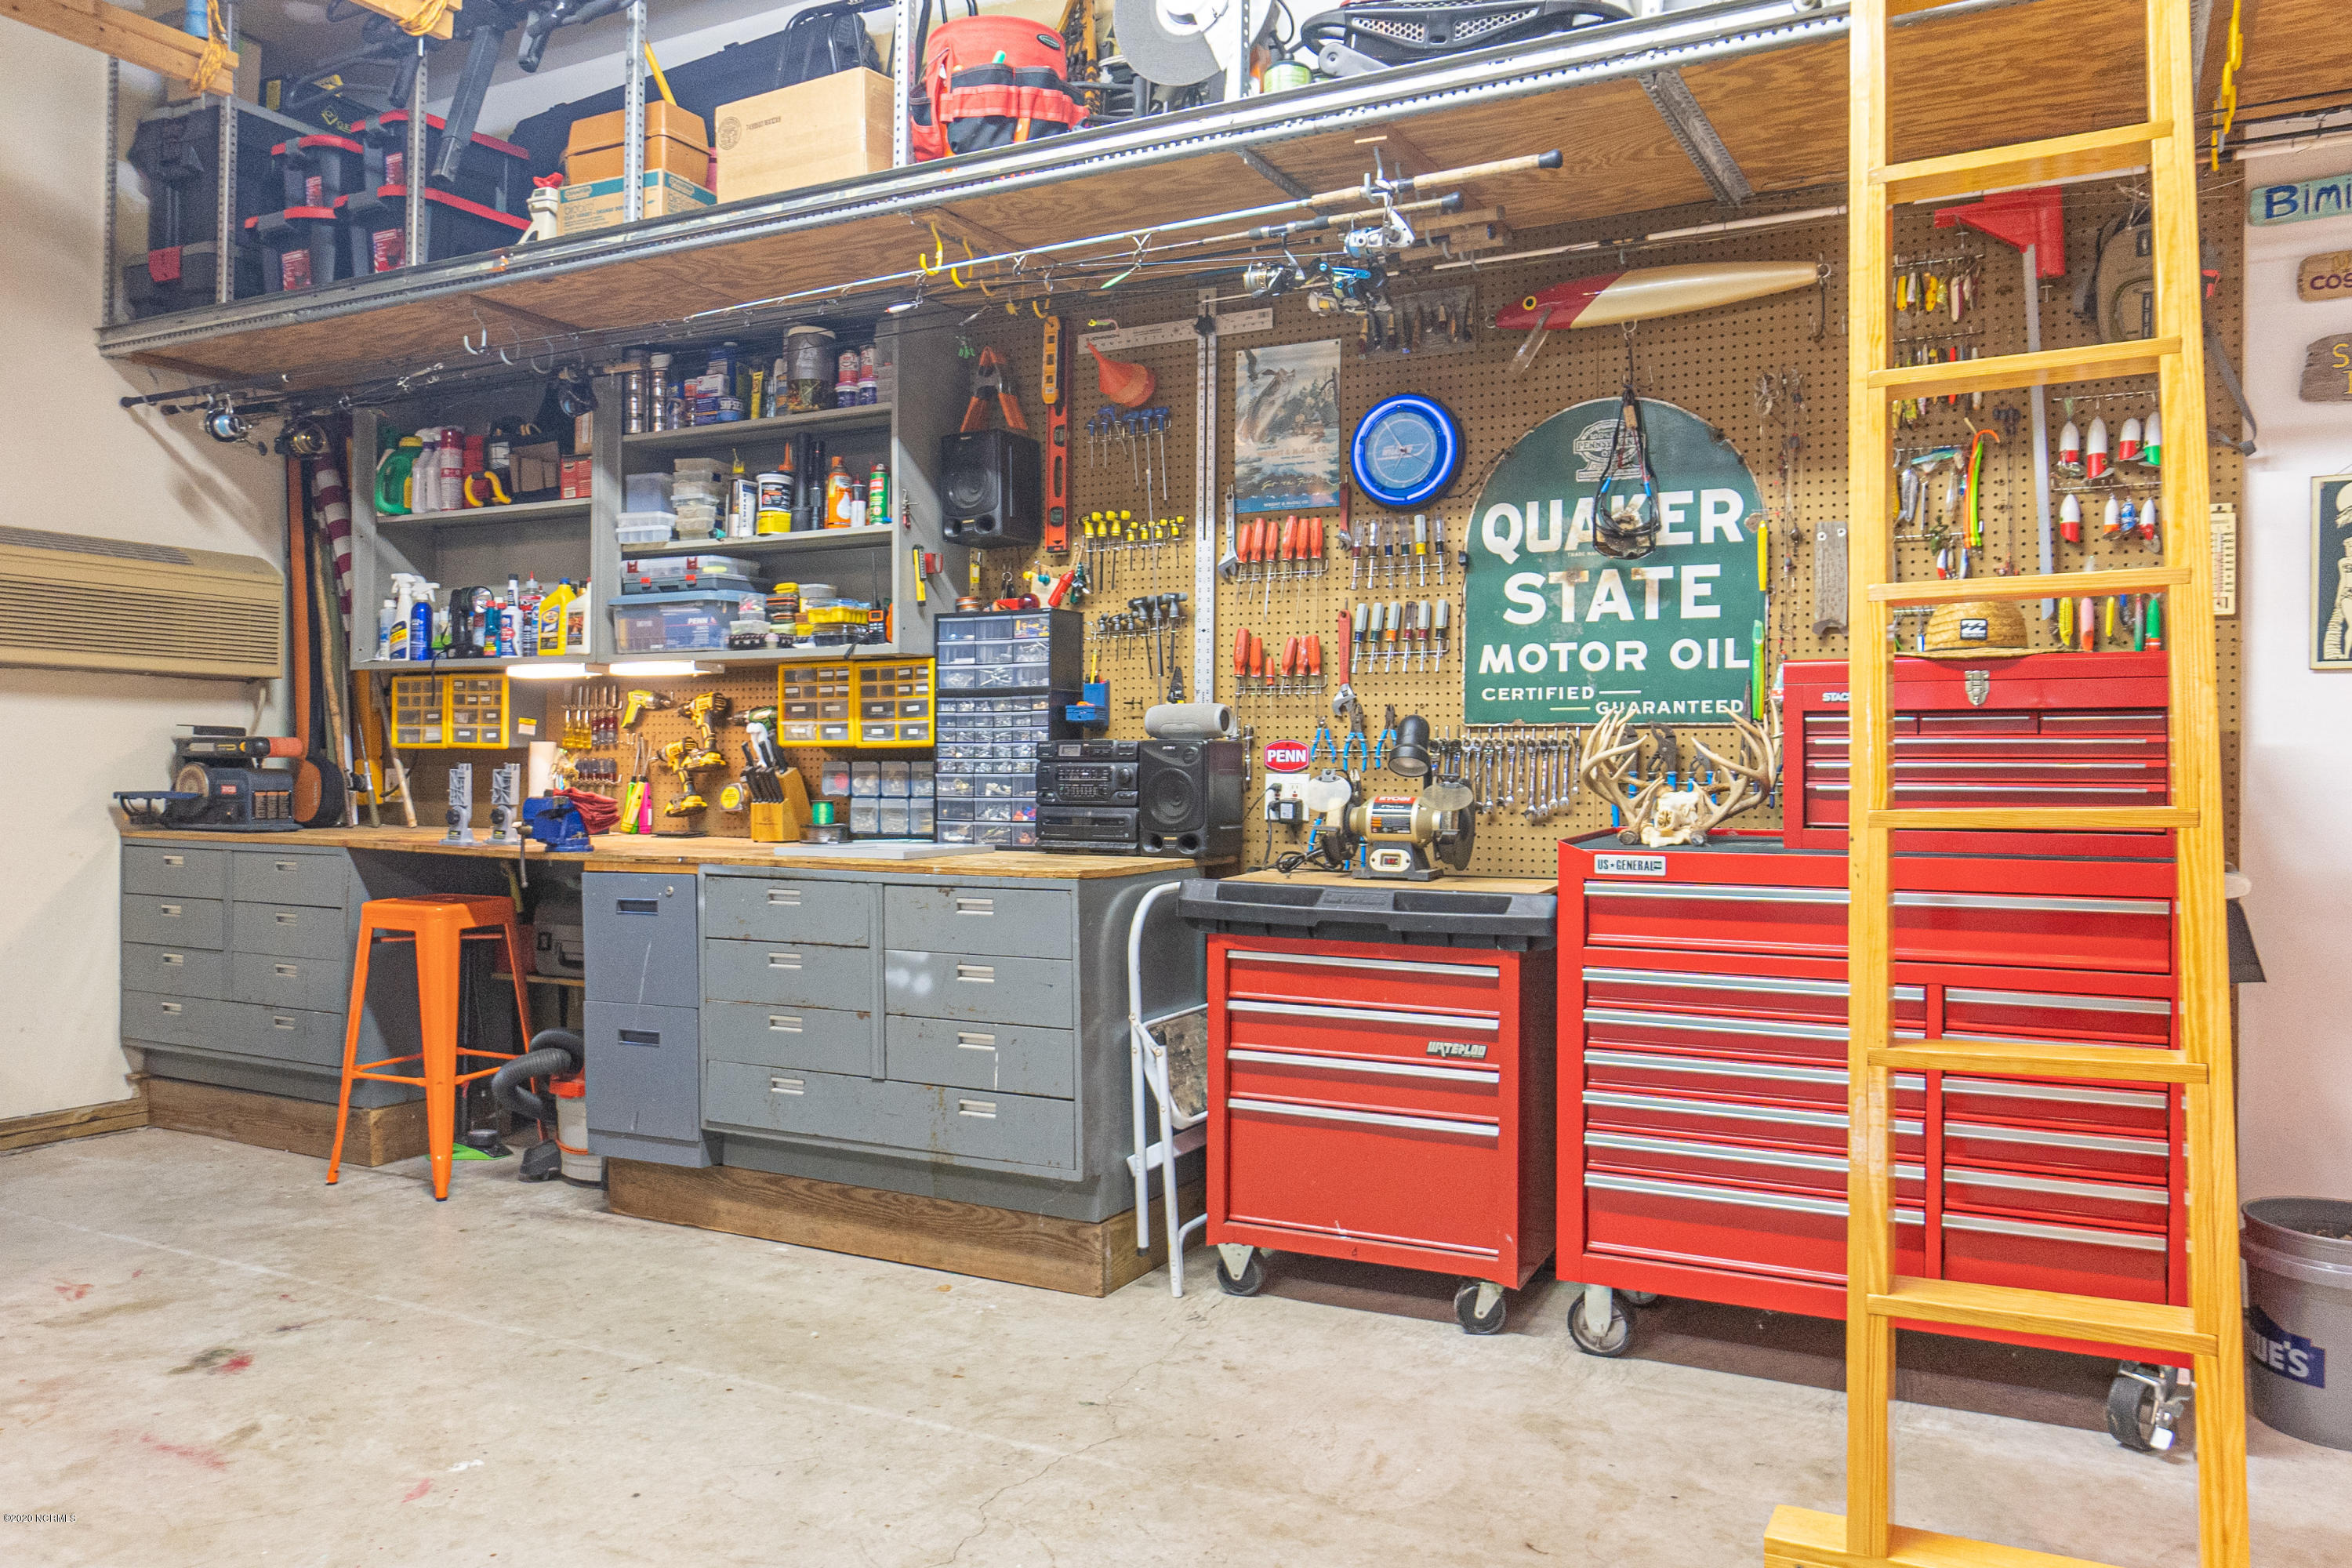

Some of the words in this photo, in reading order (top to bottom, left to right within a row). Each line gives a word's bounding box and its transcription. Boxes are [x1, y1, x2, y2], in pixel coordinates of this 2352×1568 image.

[1482, 488, 1744, 564] QUAKER
[1503, 564, 1721, 625] STATE
[1479, 641, 1648, 673] MOTOR
[1669, 637, 1751, 670] OIL
[1482, 686, 1595, 700] CERTIFIED
[1822, 691, 1849, 702] STAC
[1595, 699, 1744, 715] GUARANTEED
[1267, 750, 1307, 764] PENN
[1597, 858, 1609, 869] US
[1616, 859, 1654, 871] GENERAL
